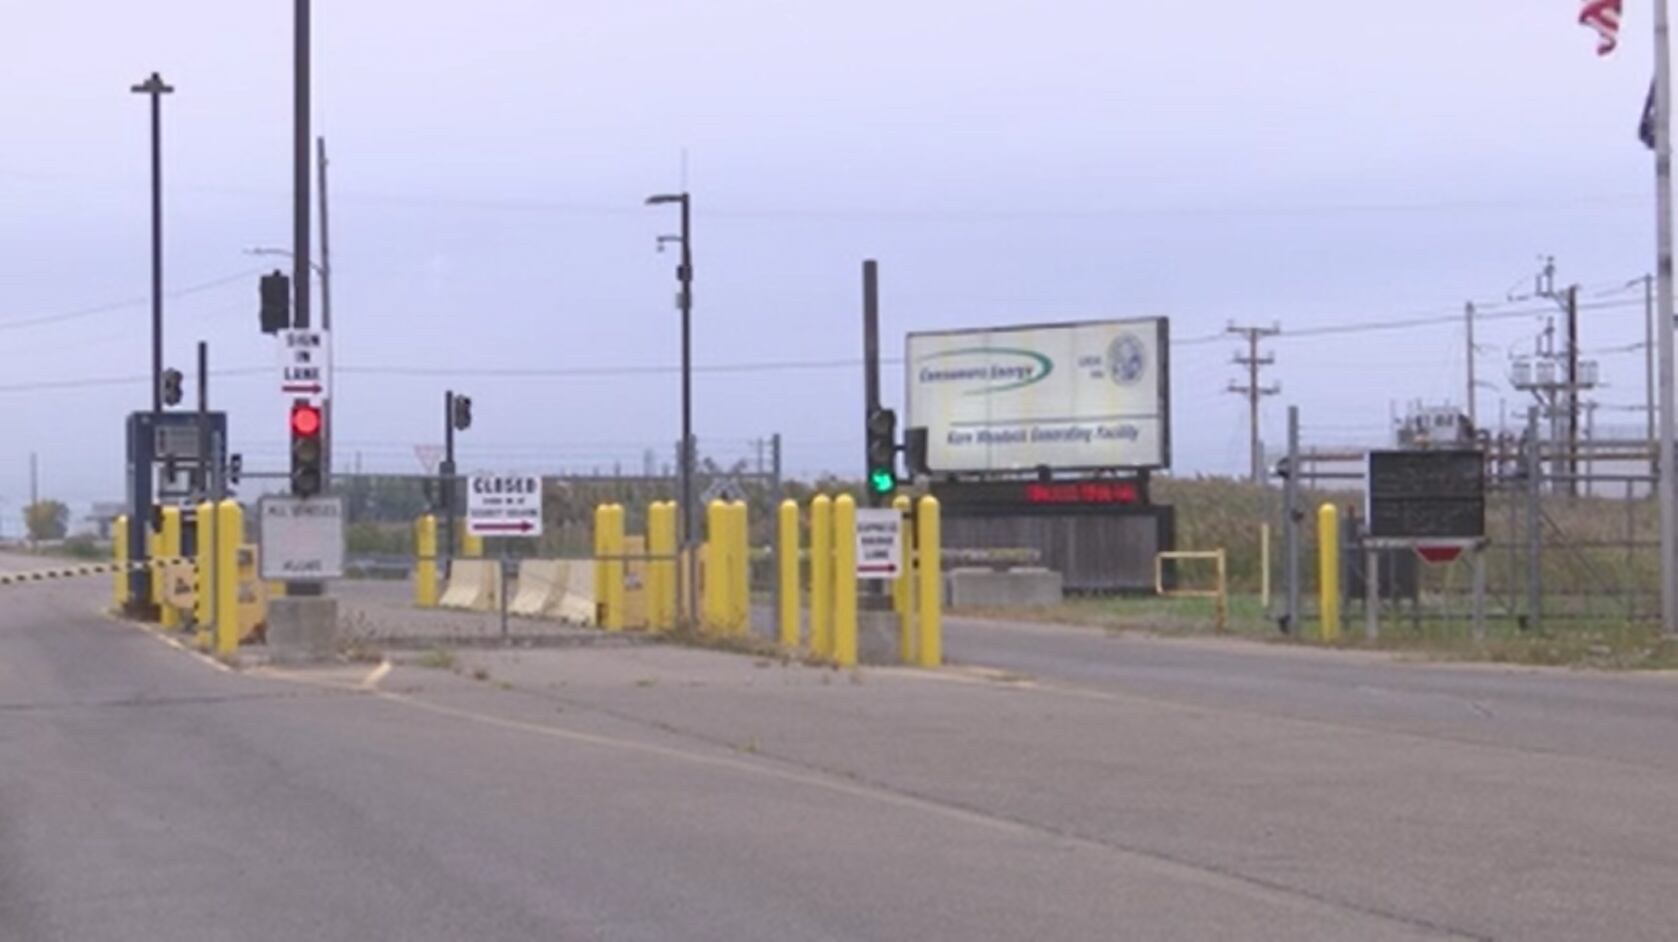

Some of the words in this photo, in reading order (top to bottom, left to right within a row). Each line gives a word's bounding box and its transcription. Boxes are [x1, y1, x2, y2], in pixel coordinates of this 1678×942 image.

[287, 333, 320, 348] SIGN
[295, 351, 310, 363] IN
[284, 367, 319, 380] LANE
[473, 477, 536, 494] CLOSED
